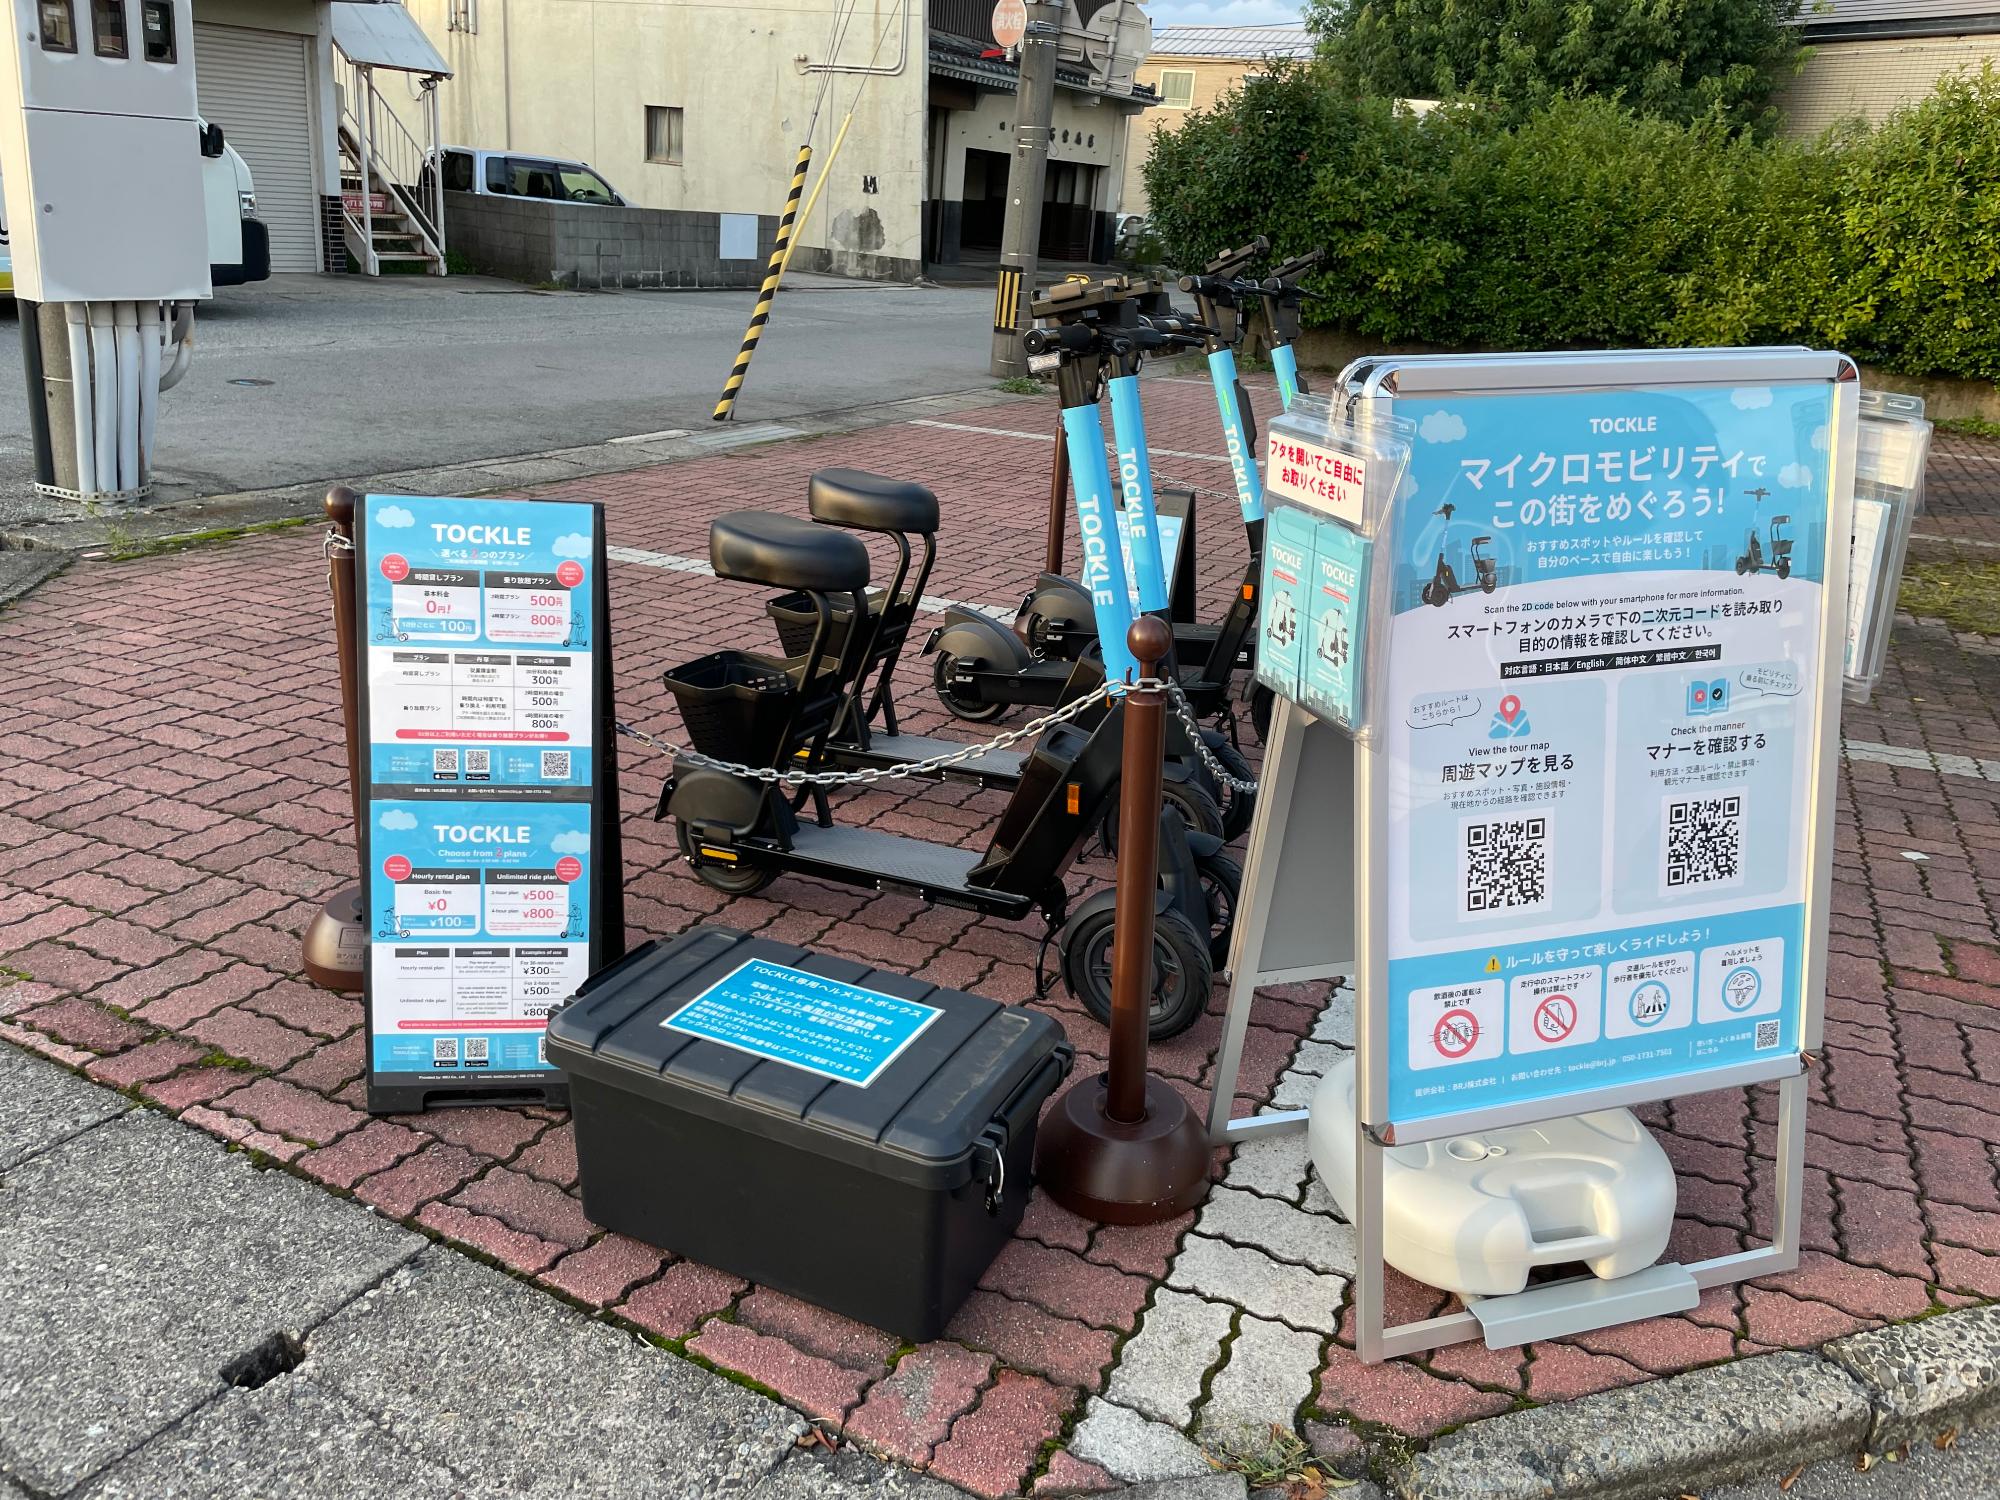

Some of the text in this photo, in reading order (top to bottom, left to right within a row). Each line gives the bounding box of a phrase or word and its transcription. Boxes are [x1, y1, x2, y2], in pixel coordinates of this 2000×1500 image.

[1589, 416, 1657, 434] TOCKLE
[1225, 424, 1253, 505] TOCKLE
[1270, 440, 1363, 485] フタを開いてご自由に
[1461, 445, 1766, 490] マイクロモビリティで
[1120, 447, 1147, 539] TOCKLE
[1281, 466, 1346, 502] お取りください
[431, 523, 532, 546] TOCKLE
[1527, 530, 1704, 553] おすすめスポットやルールを確認して
[1079, 494, 1114, 606] TOCKLE
[1271, 546, 1302, 571] TOCKLE
[1321, 561, 1356, 588] TOCKLE
[1484, 605, 1505, 614] Scan
[1506, 604, 1520, 613] the
[1521, 603, 1533, 612] 2D
[1534, 602, 1554, 611] code
[1556, 600, 1579, 609] below
[1581, 598, 1598, 607] with
[1599, 598, 1618, 608] your
[1619, 593, 1665, 605] smartphone
[1666, 592, 1678, 600] for
[1679, 591, 1699, 600] more
[1447, 599, 1783, 640] スマートフォンのカメラで下の二次元コードを読み取り
[1519, 624, 1713, 654] 目的の情報を確認してください。
[1413, 694, 1469, 714] おすすめルートは
[1671, 722, 1746, 737] Check the manner
[1469, 742, 1550, 757] View the tour map
[1646, 733, 1767, 761] マナーを確認する
[1441, 753, 1574, 783] 周遊マップを見る
[1664, 769, 1748, 786] 観光マナーを確認できます
[1450, 790, 1566, 810] 現在地からの経路を確認できます
[433, 825, 531, 844] TOCKLE
[438, 849, 471, 857] Choose
[473, 849, 493, 857] from
[504, 849, 527, 858] plans
[412, 873, 434, 881] Hourly
[455, 873, 470, 881] plan
[428, 898, 447, 910] ¥0
[523, 890, 554, 900] ¥500
[430, 917, 461, 927] ¥100
[523, 908, 554, 918] ¥800
[1724, 945, 1760, 958] ヘルメットを
[523, 966, 550, 975] ¥300
[1520, 971, 1593, 989] 走行中のスマートフォン
[523, 986, 550, 995] ¥500
[752, 964, 924, 1019] TOCKLE専用ヘルメットボックス
[1444, 998, 1471, 1008] 禁止です
